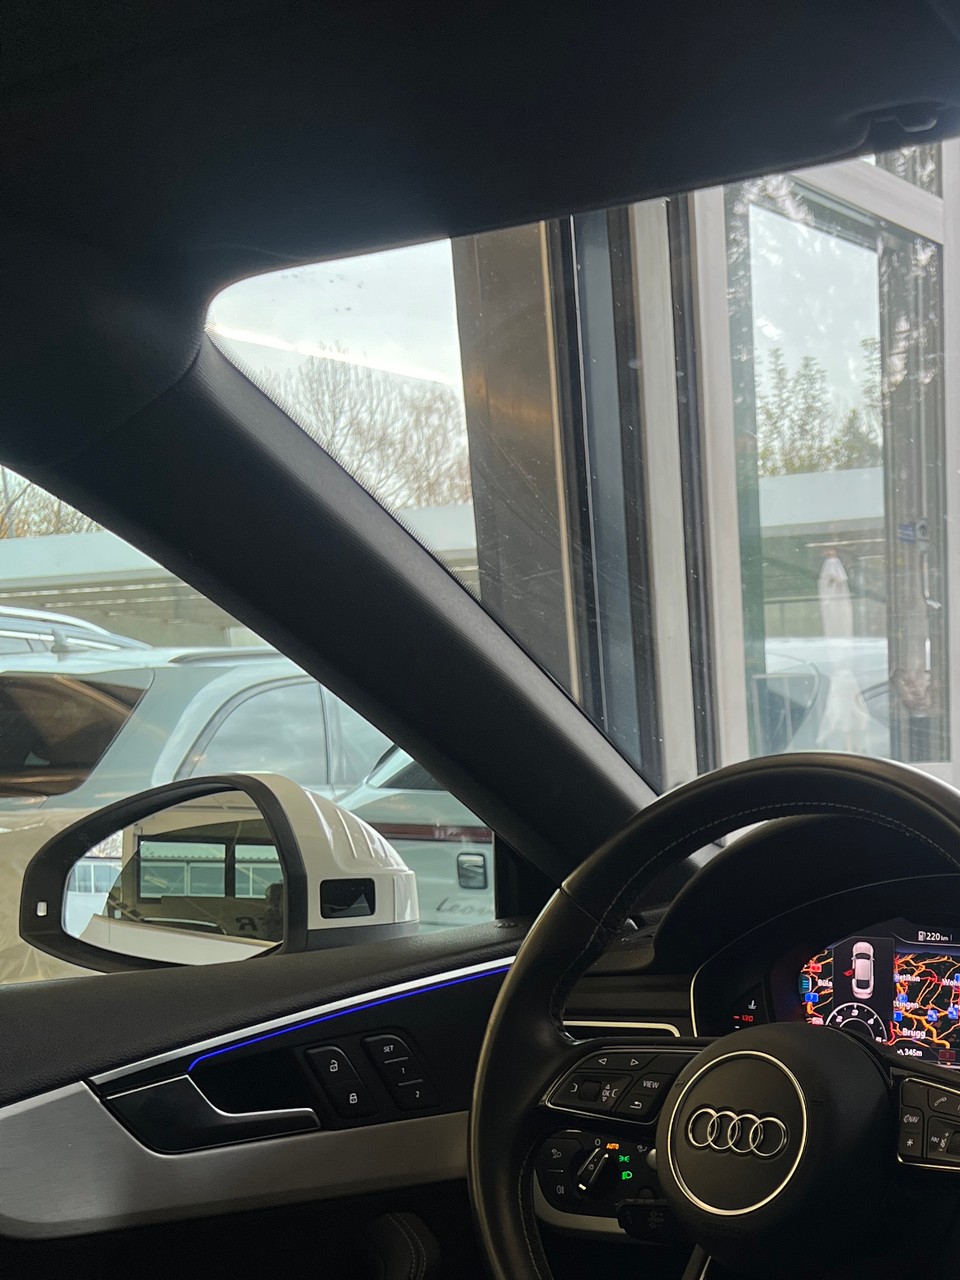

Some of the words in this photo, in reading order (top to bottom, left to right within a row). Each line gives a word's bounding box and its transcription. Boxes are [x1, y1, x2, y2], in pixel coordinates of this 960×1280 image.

[926, 932, 940, 941] 220
[835, 1015, 844, 1023] 2
[901, 1027, 927, 1039] Brugg
[383, 1044, 394, 1053] SET
[904, 1048, 923, 1057] 345m
[642, 1080, 660, 1090] VIEW
[605, 1142, 620, 1150] AUTO
